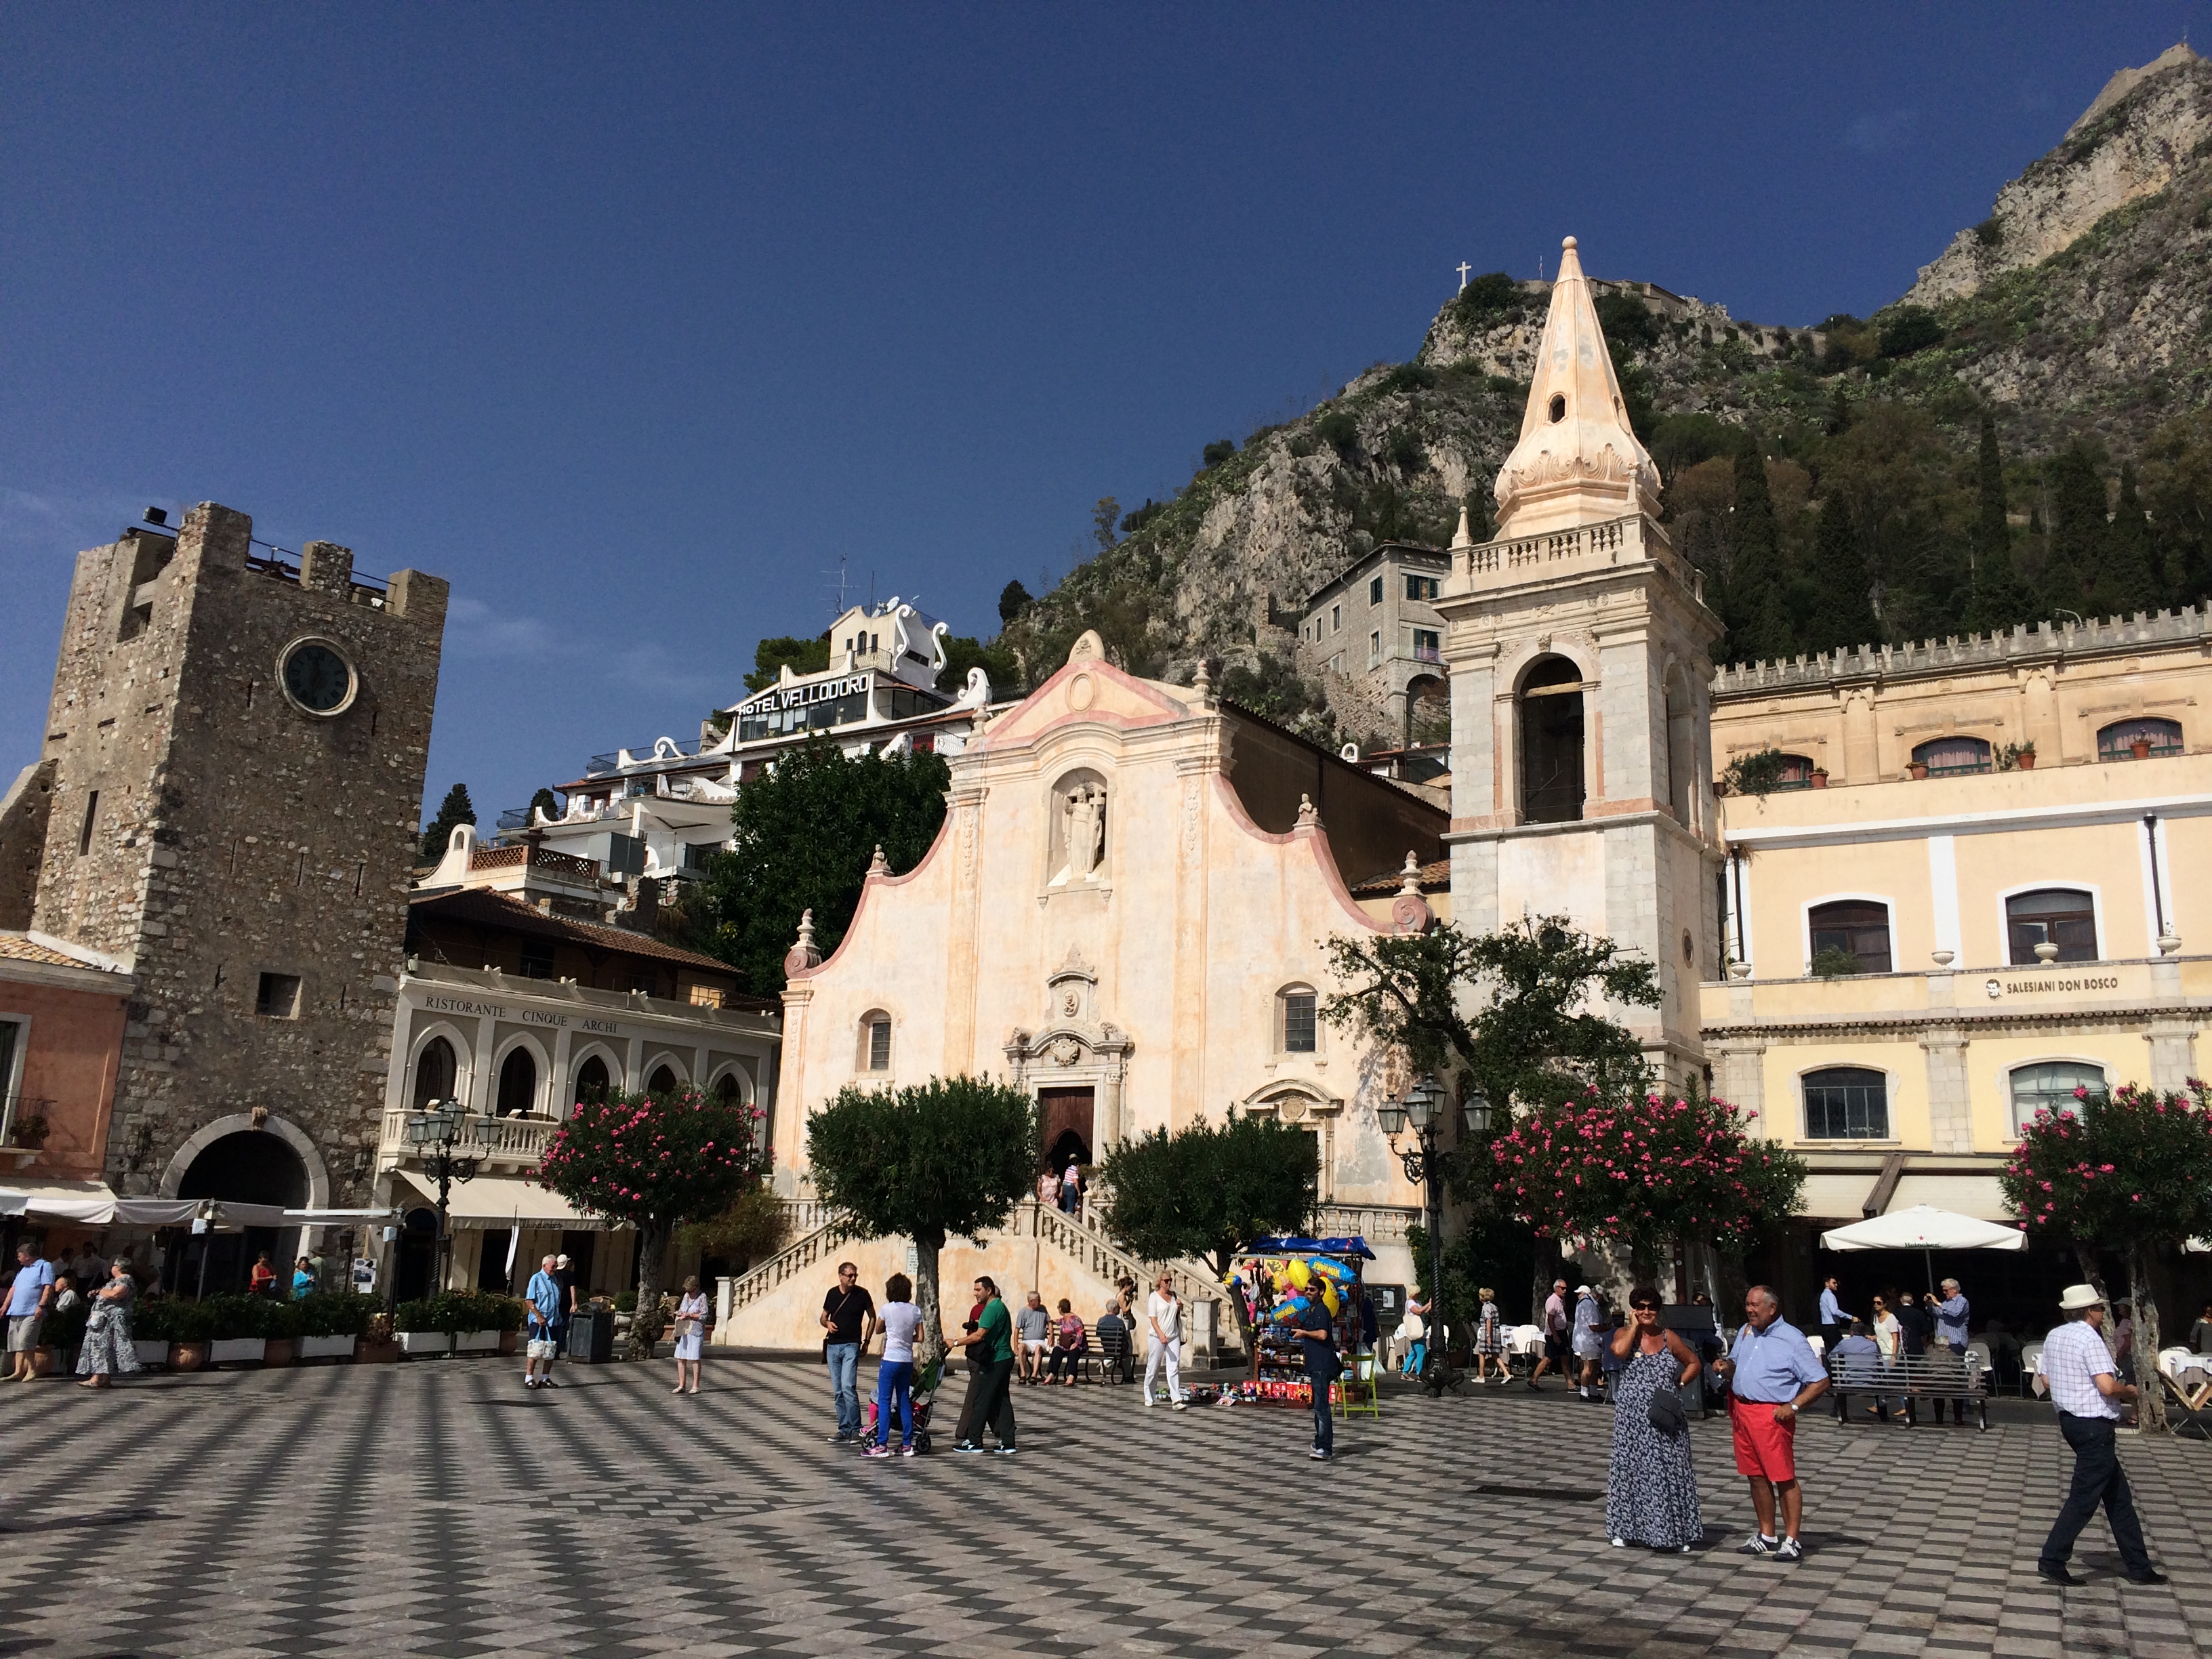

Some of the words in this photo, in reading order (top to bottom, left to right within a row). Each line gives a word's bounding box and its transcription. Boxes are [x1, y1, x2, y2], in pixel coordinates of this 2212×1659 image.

[739, 695, 779, 716] HOTEL
[2007, 981, 2055, 994] SALESIANI
[2058, 980, 2081, 991] DON
[2084, 977, 2118, 990] BOSCO
[425, 996, 506, 1018] RISTORANTE
[522, 1010, 567, 1027] CINQUE
[581, 1019, 617, 1033] ARCHI
